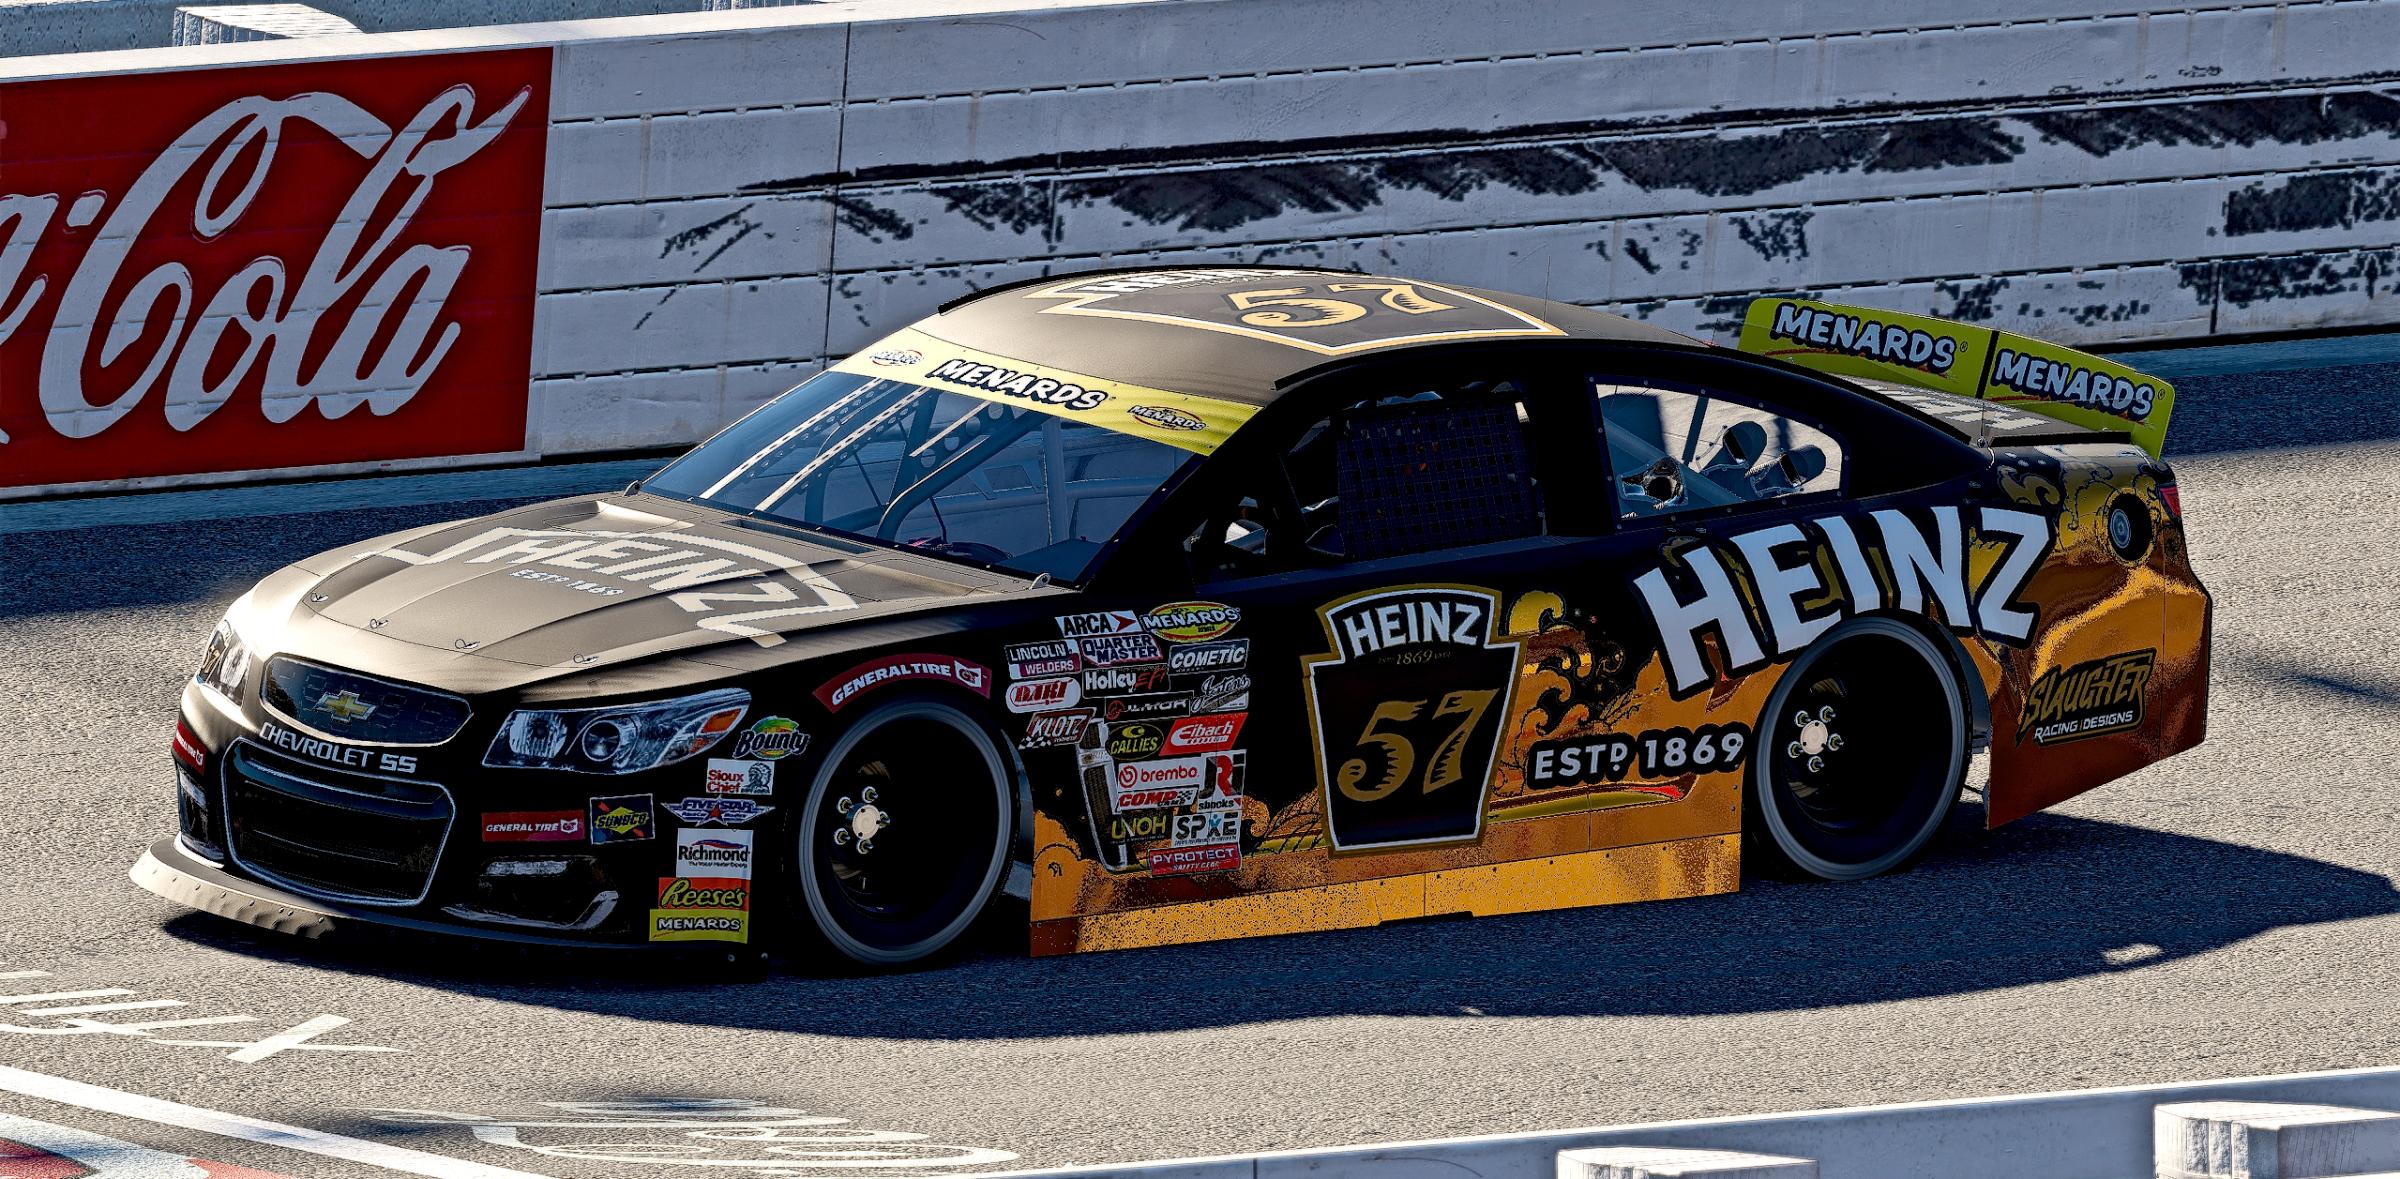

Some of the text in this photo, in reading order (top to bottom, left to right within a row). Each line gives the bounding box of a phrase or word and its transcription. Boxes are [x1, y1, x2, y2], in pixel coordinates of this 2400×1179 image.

[1226, 282, 1461, 328] 57
[1775, 304, 1957, 367] MENARDS
[930, 359, 1108, 410] MENARDS
[1996, 351, 2155, 416] MENARDS
[1128, 405, 1206, 430] MENARDS
[463, 538, 800, 613] HEINZ
[1633, 505, 2050, 692] HEINZ
[1063, 613, 1113, 636] ARCA
[1141, 608, 1240, 629] MENARDS
[1343, 601, 1482, 659] HEINZ
[1009, 644, 1067, 662] LINCOLN
[1083, 636, 1151, 657] QUARTER
[1098, 647, 1159, 664] MASTER
[1171, 647, 1246, 669] COMETIC
[1396, 649, 1433, 665] 1869
[1025, 659, 1074, 675] WELDERS
[832, 663, 911, 705] GENERAL
[910, 663, 952, 676] TIRE
[1085, 670, 1137, 693] Holley
[2025, 660, 2152, 722] SLAUGHTER
[1031, 715, 1088, 738] KLOTZ
[1171, 721, 1233, 746] Eibach
[2034, 710, 2134, 743] RACING DESIGNS
[259, 721, 418, 774] CHEVROLET SS
[733, 730, 810, 759] Bounty
[1111, 737, 1158, 755] CALLIES
[1337, 687, 1500, 802] 57
[1645, 732, 1744, 768] 1869
[709, 769, 745, 782] Sioux
[1141, 765, 1199, 782] brembo
[706, 781, 742, 793] Chief
[1119, 790, 1179, 807] COMP
[682, 799, 755, 813] FIVE STAR
[1198, 799, 1235, 811] shocks
[486, 823, 540, 832] GENERAL
[540, 822, 559, 832] TIRE
[595, 811, 649, 830] SUNOCO
[1111, 815, 1167, 840] UNOH
[678, 845, 750, 862] Richmond
[1152, 848, 1235, 865] PYROTECT
[660, 878, 746, 909] Reese's
[658, 917, 742, 931] MENARDS
